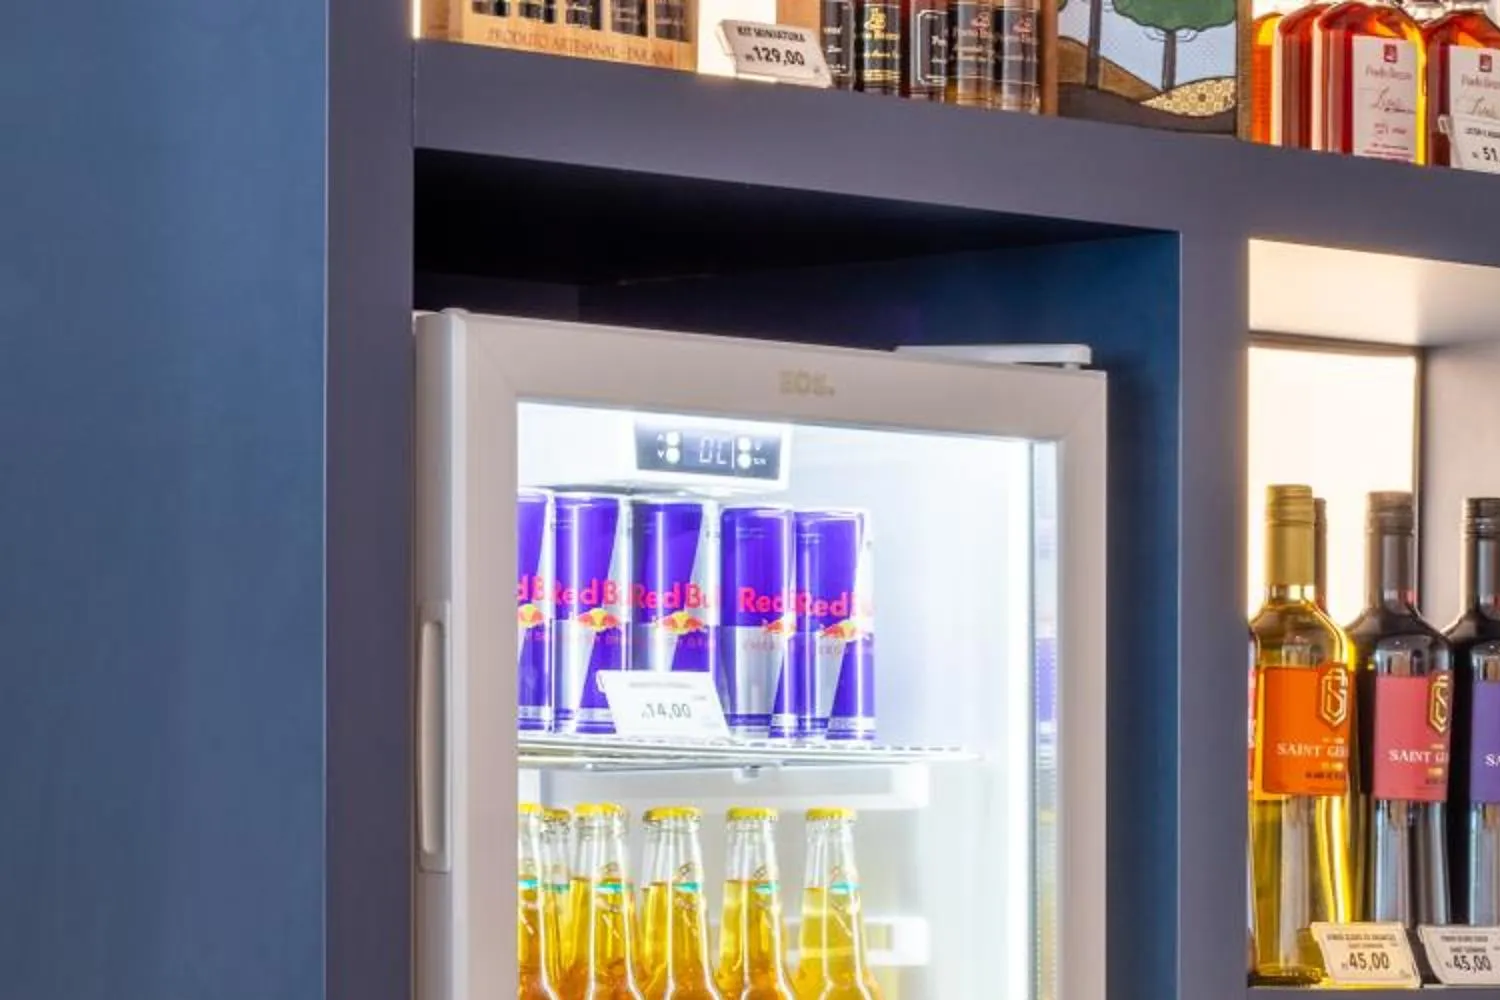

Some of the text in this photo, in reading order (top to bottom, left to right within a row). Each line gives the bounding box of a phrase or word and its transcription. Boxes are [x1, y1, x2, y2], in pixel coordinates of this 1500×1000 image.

[753, 45, 805, 66] 129,00
[1277, 742, 1320, 758] SAINT
[1389, 749, 1432, 763] SAINT
[1349, 952, 1390, 971] 45,00
[1453, 955, 1492, 973] 45,00
